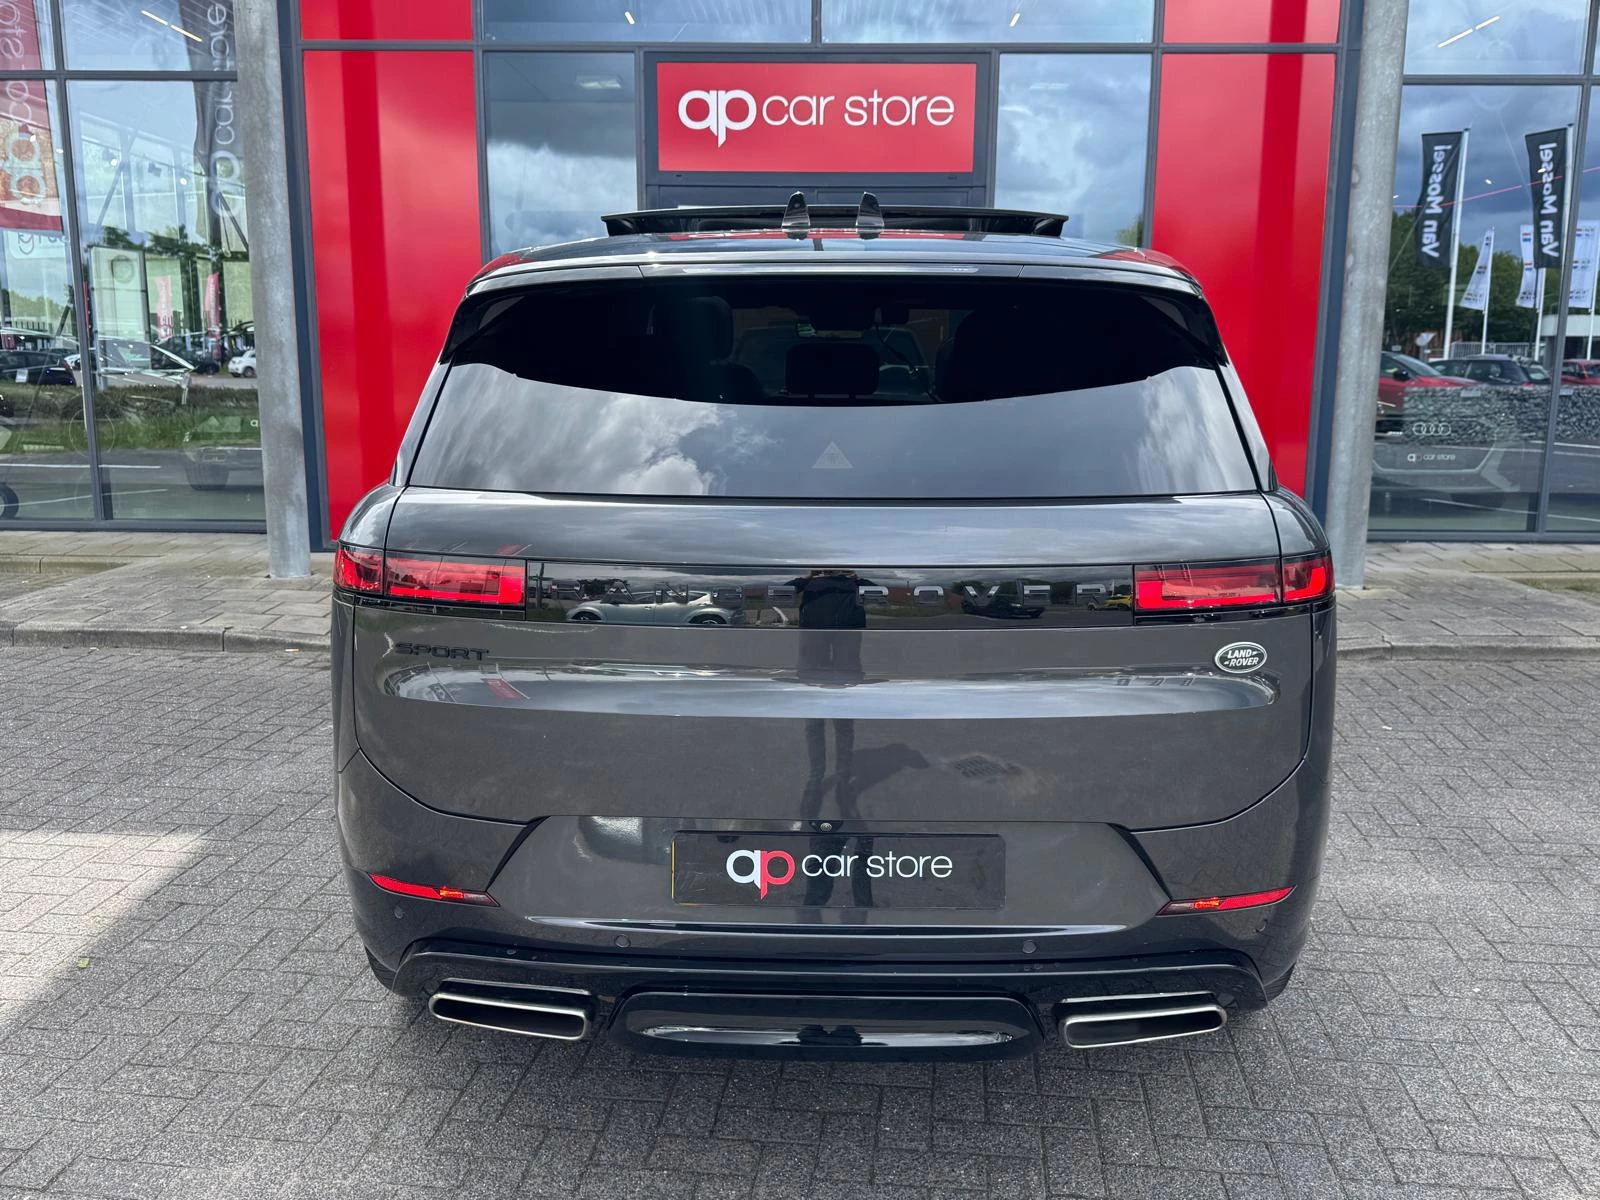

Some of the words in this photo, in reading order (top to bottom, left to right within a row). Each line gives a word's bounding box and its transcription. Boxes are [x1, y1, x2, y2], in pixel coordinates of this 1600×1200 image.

[677, 89, 758, 149] ap
[761, 94, 836, 127] car
[843, 88, 956, 127] store
[394, 642, 491, 662] SPORT
[1227, 648, 1253, 659] LAND
[1229, 656, 1260, 668] ROVER
[725, 849, 796, 900] ap
[801, 854, 859, 878] car
[865, 850, 953, 879] store
